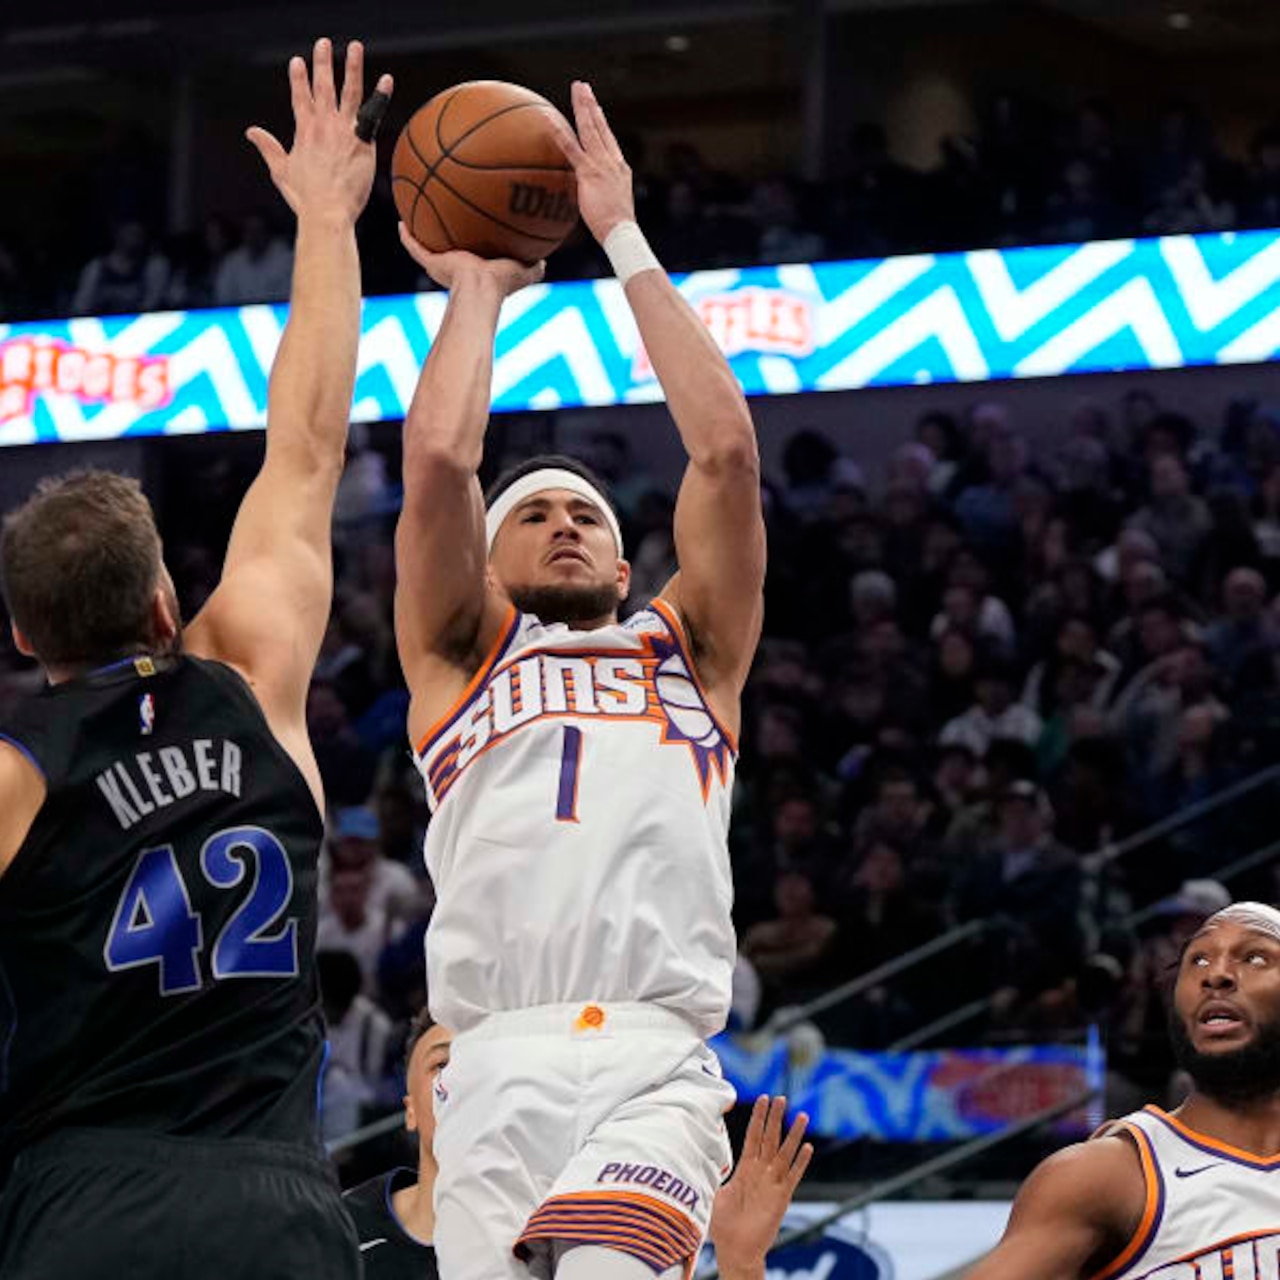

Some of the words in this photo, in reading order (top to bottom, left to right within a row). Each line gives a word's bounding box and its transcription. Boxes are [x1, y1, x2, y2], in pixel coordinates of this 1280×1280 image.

[95, 738, 243, 830] KLEBER
[554, 724, 585, 824] 1
[103, 824, 300, 998] 42
[596, 1161, 701, 1213] PHOENIX
